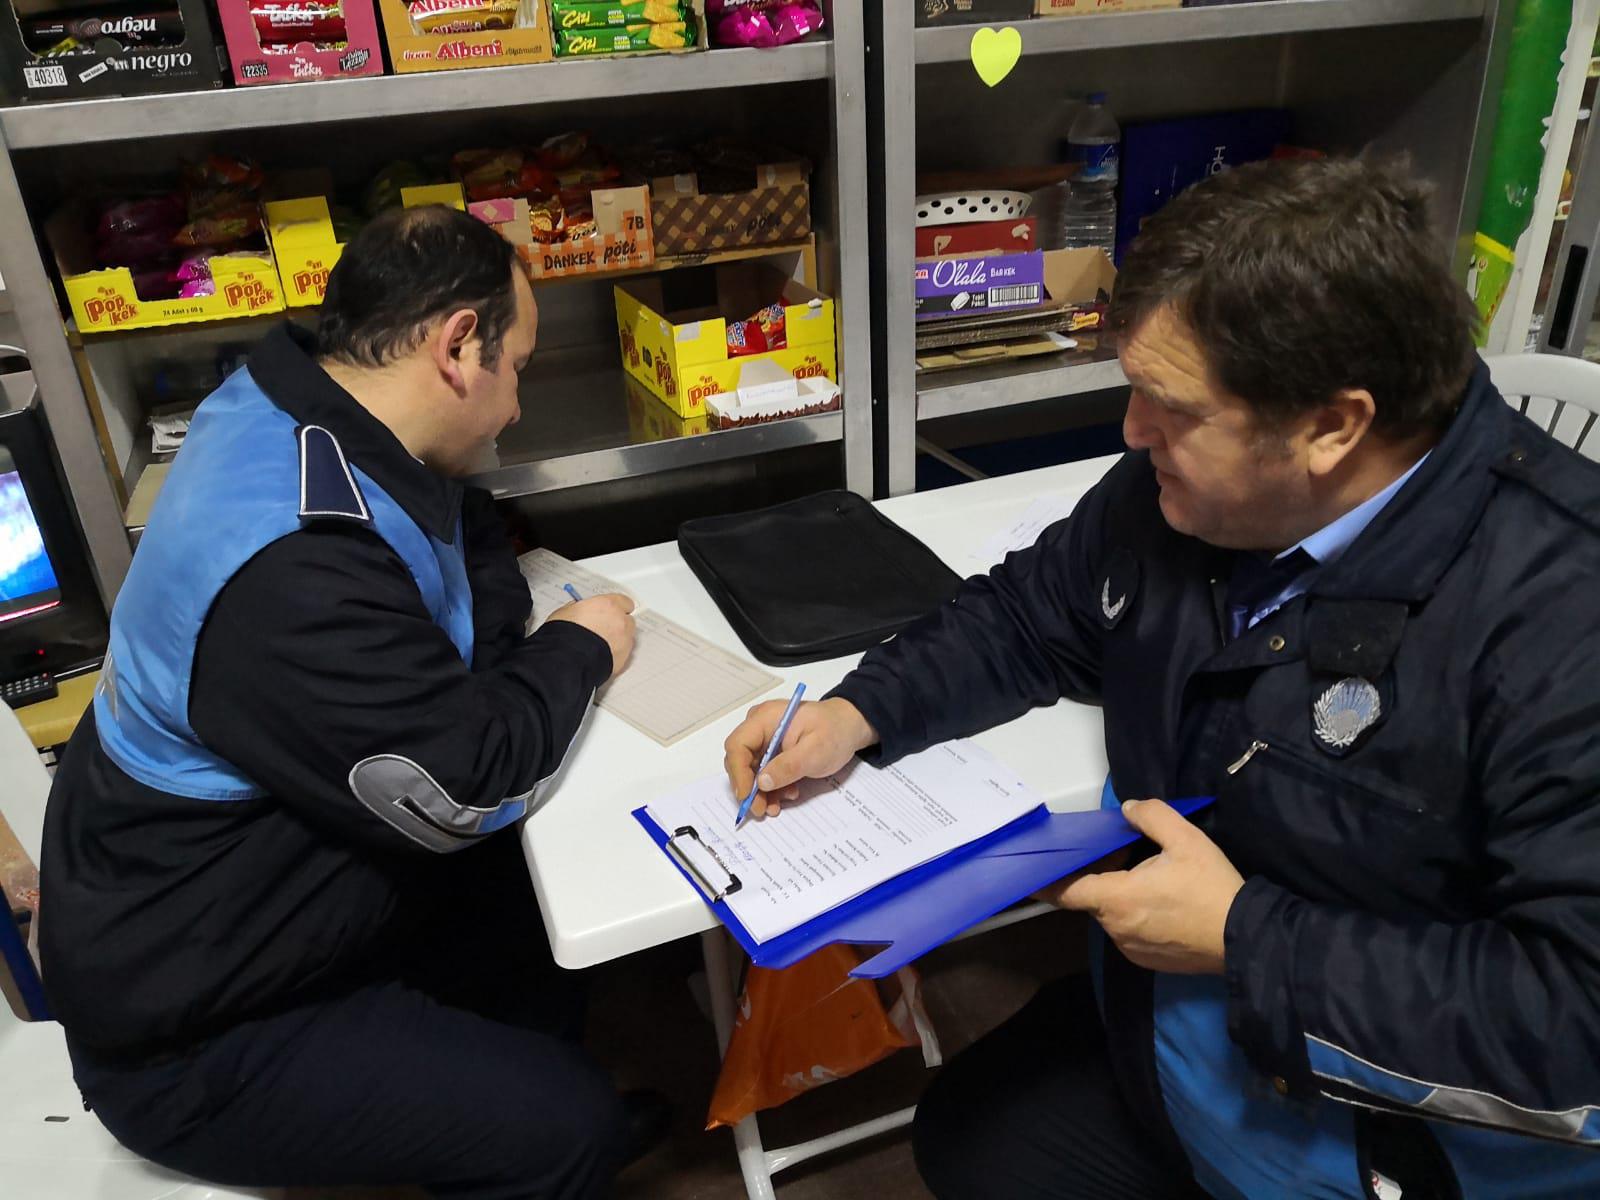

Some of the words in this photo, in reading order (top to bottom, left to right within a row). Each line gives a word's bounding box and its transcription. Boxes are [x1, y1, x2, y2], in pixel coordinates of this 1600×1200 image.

[101, 16, 157, 34] negro
[436, 39, 504, 60] Albeni
[131, 52, 192, 73] negro
[34, 67, 65, 85] 40318
[626, 215, 645, 230] 7B
[543, 251, 596, 271] DANKEK
[603, 239, 637, 264] pöti
